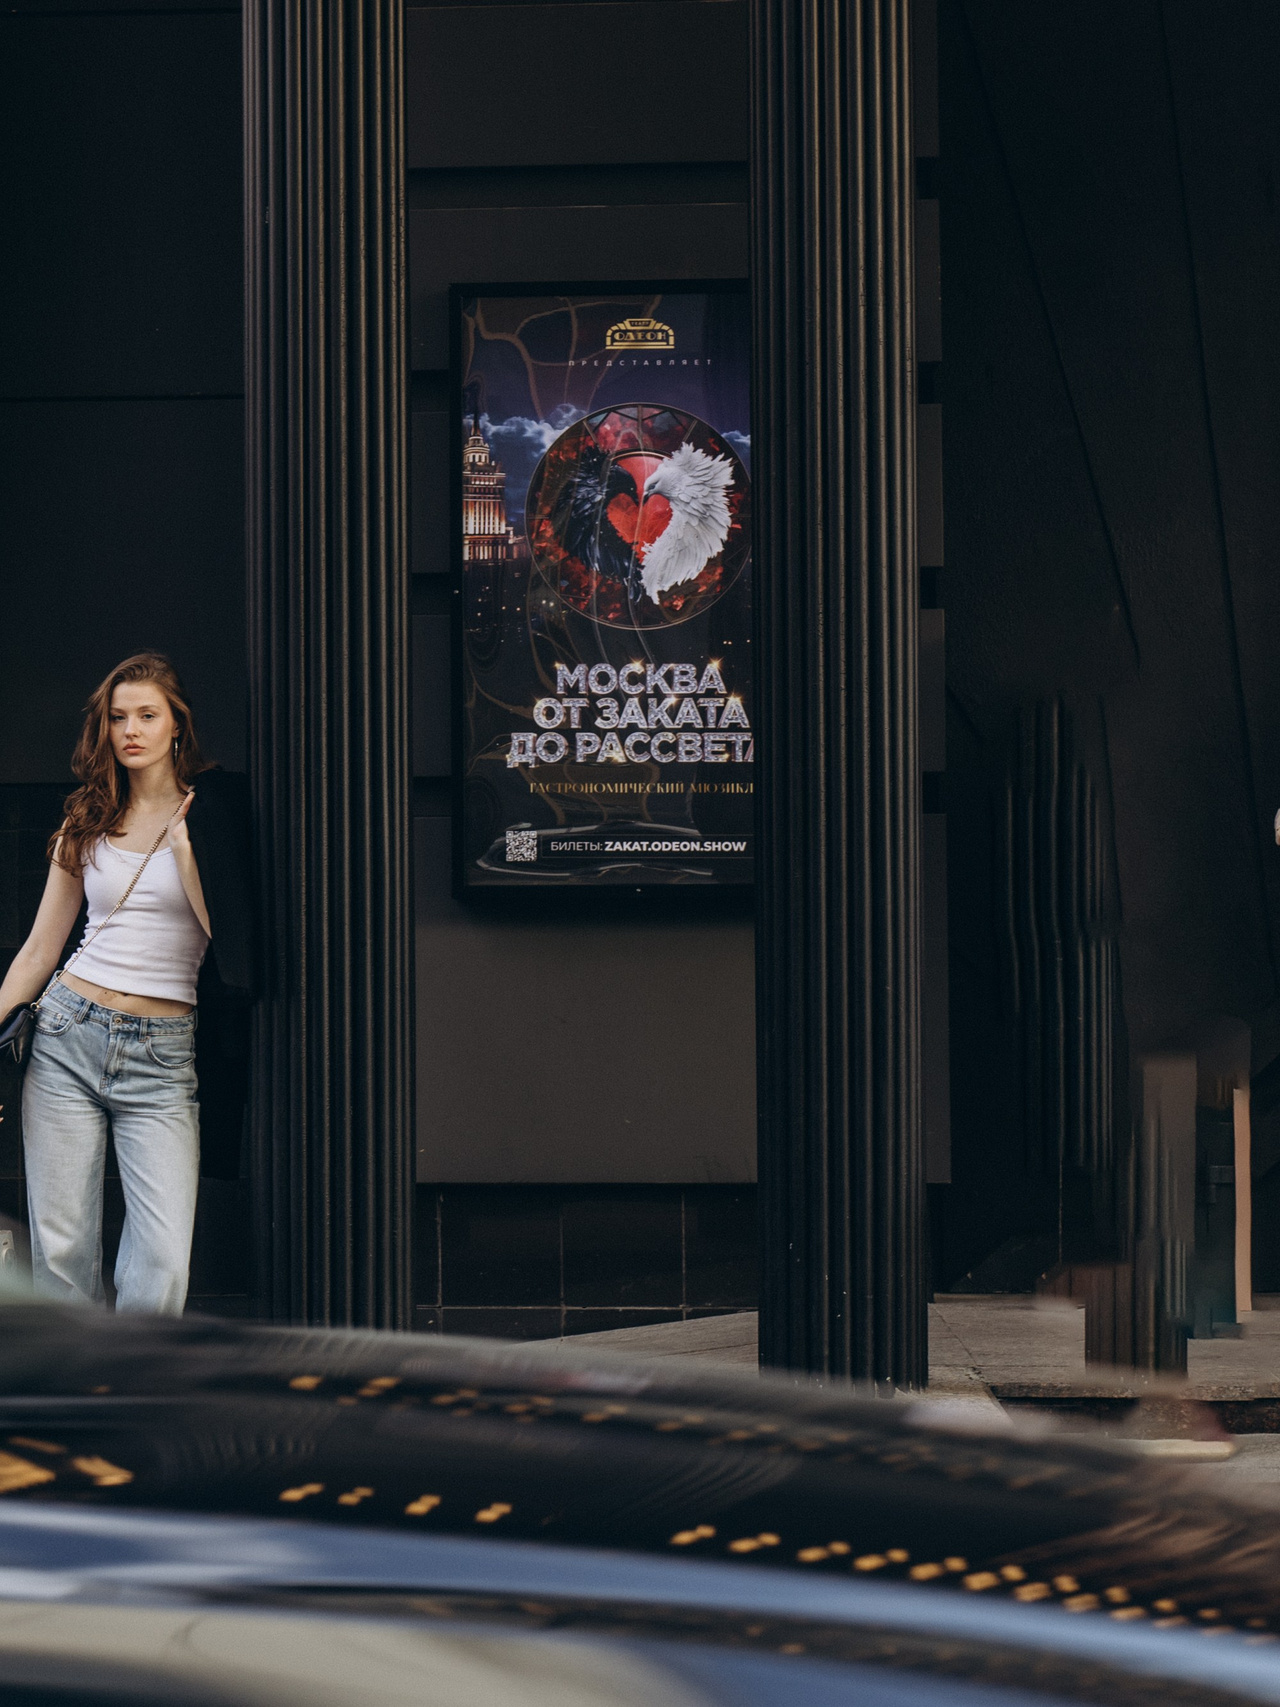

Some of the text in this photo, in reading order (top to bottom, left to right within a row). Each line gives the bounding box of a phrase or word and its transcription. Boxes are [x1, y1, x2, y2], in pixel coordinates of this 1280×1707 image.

[613, 331, 667, 341] ОДЕОН
[568, 359, 712, 367] ПРЕДСТАВЛЯЕТ
[555, 661, 727, 695] МОСКВА
[532, 696, 750, 729] ОТ ЗАКАТА
[506, 731, 569, 768] ДО
[529, 781, 754, 794] ГАСТРОНОМИЧЕСКИЙ МЮЗИКЛ
[550, 841, 747, 852] БИЛЕТЫ: ZAKAT.ODEON.SHOW
